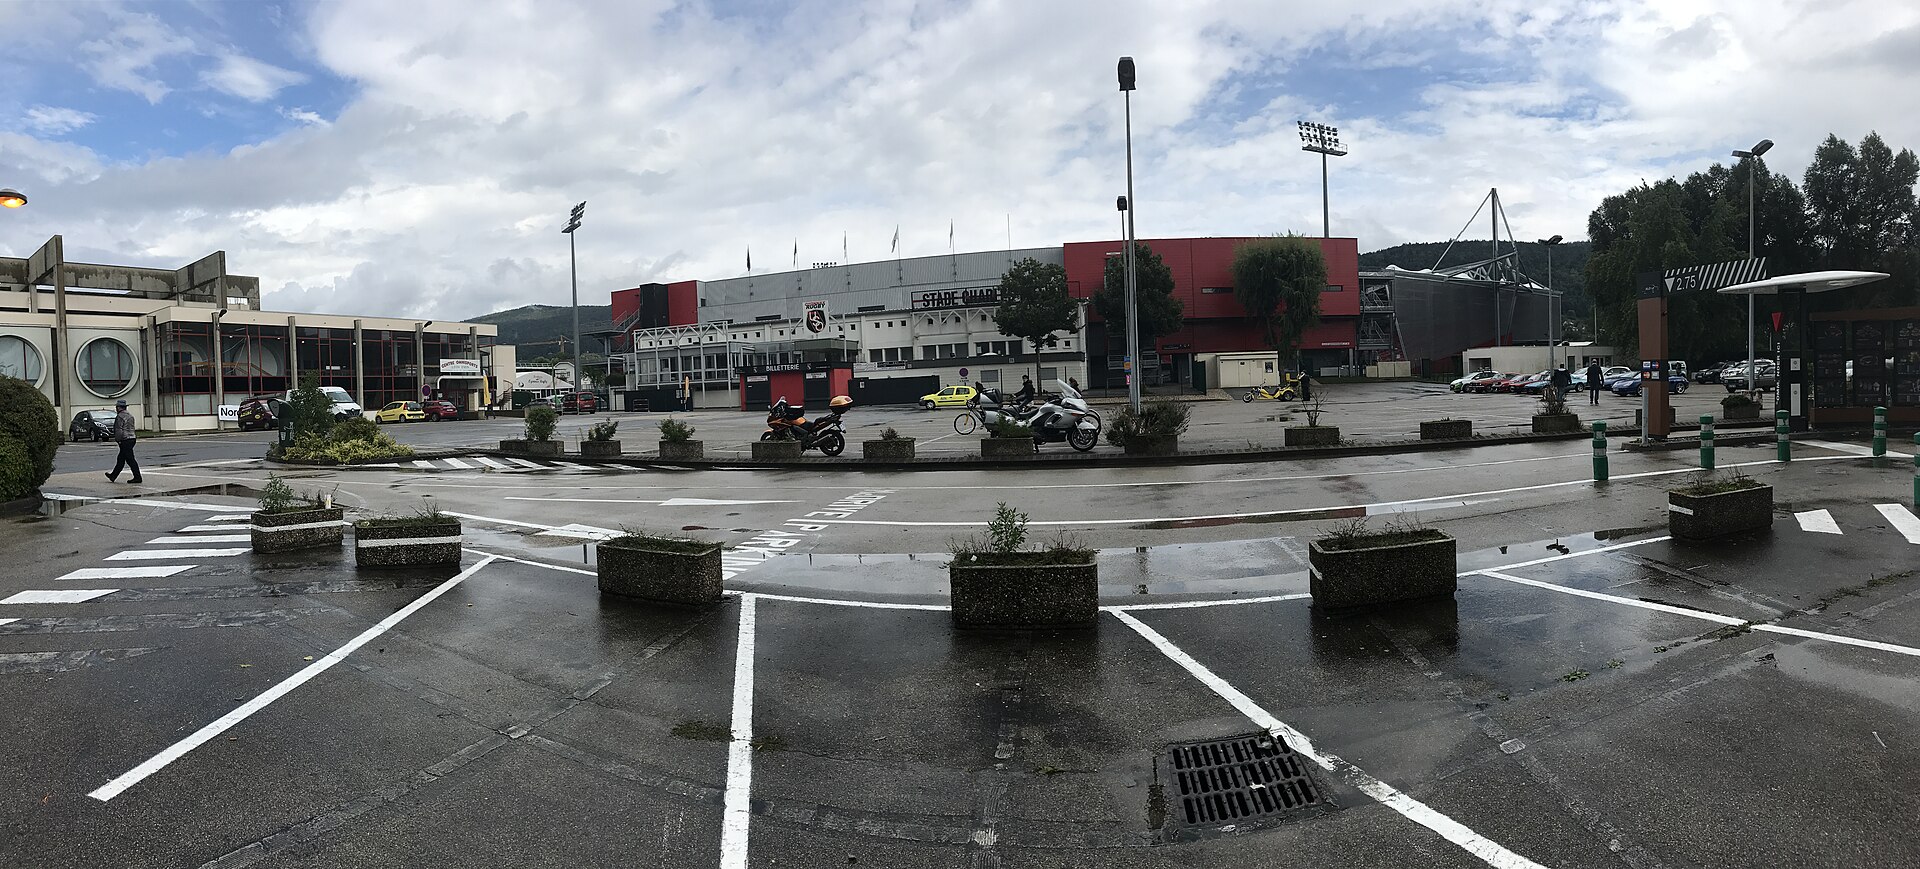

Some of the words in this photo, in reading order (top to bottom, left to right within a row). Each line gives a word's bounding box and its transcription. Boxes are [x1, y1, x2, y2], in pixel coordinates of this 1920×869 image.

[1676, 275, 1696, 291] 2.75
[922, 291, 958, 307] STADE
[962, 288, 1000, 305] CHARL
[765, 364, 800, 372] BILLETTERIE
[220, 408, 240, 417] Nor
[722, 523, 829, 580] PARKIN
